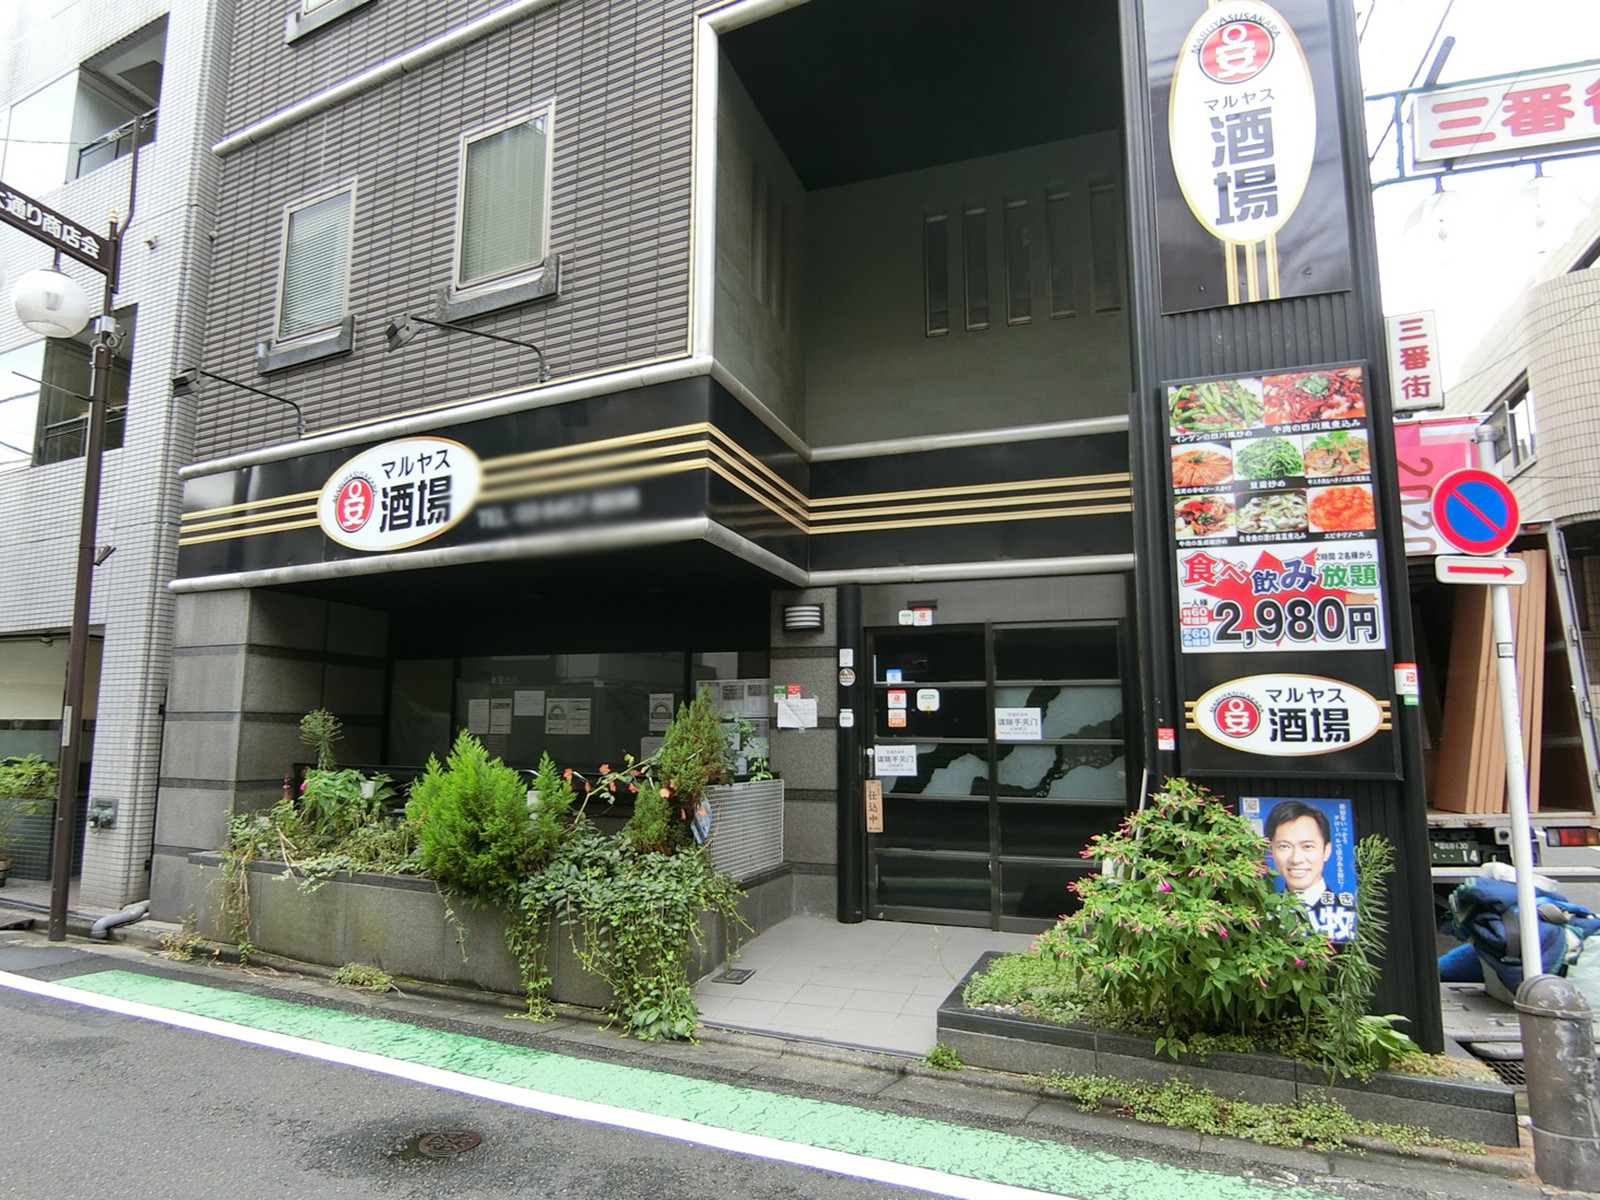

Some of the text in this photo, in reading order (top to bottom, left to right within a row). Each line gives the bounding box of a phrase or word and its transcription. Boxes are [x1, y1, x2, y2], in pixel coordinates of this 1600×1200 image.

[1204, 87, 1276, 111] マルヤス
[1429, 79, 1600, 149] 三番
[1209, 106, 1279, 226] 酒場
[0, 191, 100, 260] 通り商店会
[1398, 317, 1431, 400] 三番街
[381, 449, 451, 479] マルヤス
[380, 475, 453, 533] 酒場
[1316, 550, 1373, 561] 2時間 2名様から
[1265, 688, 1346, 704] マルヤス
[1269, 707, 1350, 743] 酒場
[868, 791, 878, 824] 仕込中
